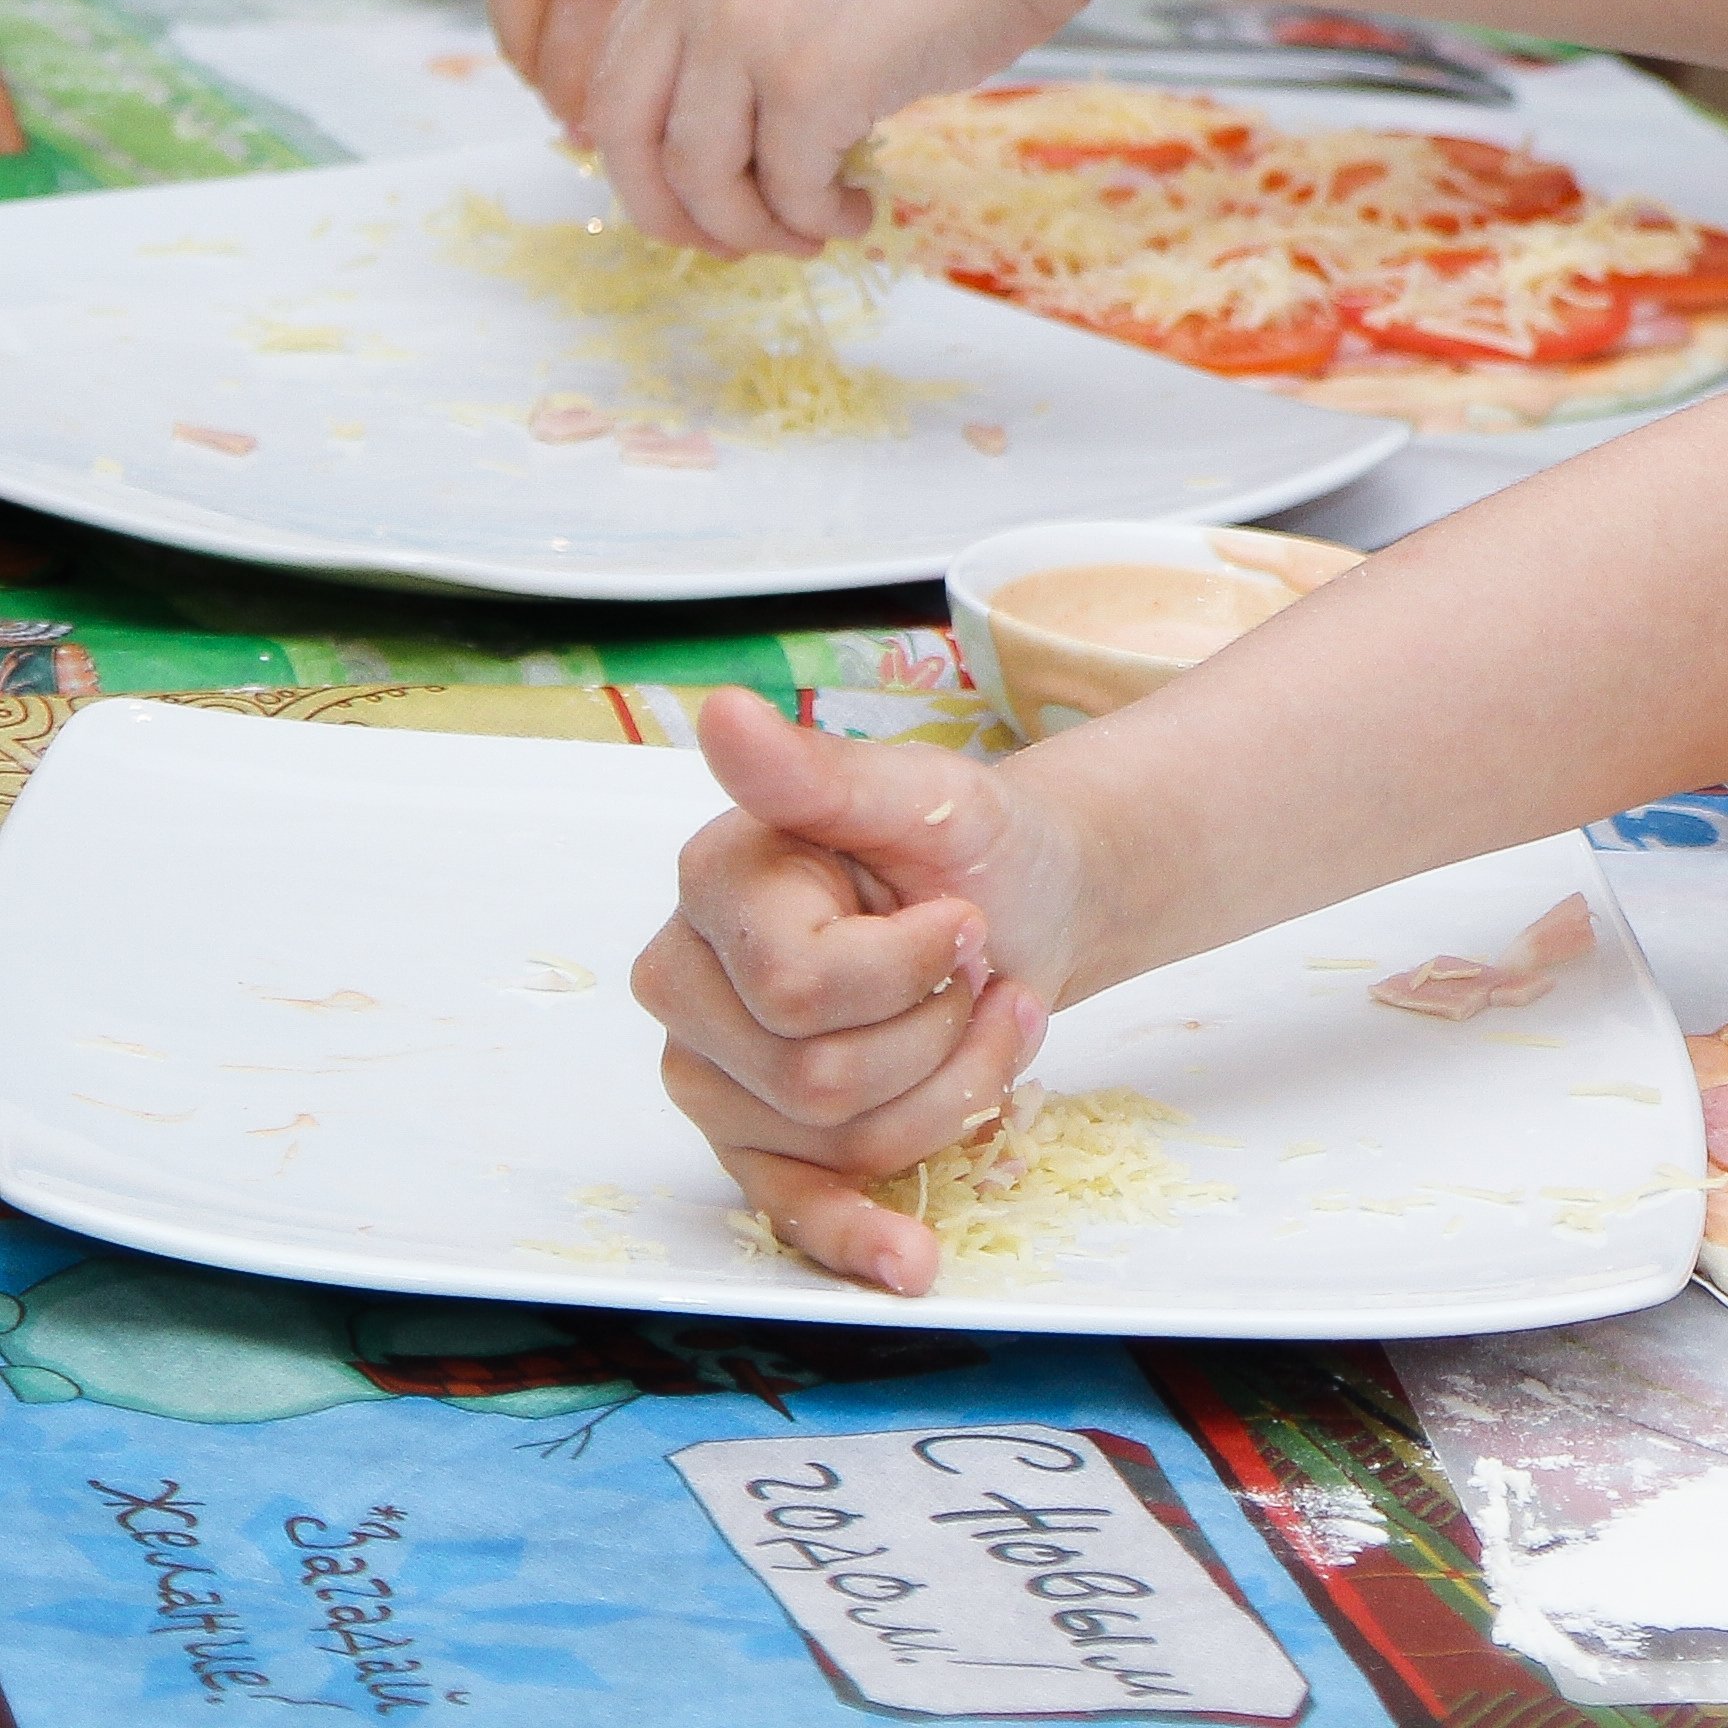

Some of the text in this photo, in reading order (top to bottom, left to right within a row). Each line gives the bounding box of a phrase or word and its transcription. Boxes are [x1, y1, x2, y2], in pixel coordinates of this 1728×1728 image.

[745, 1462, 1083, 1671] годом!
[912, 1433, 1193, 1697] С Новым
